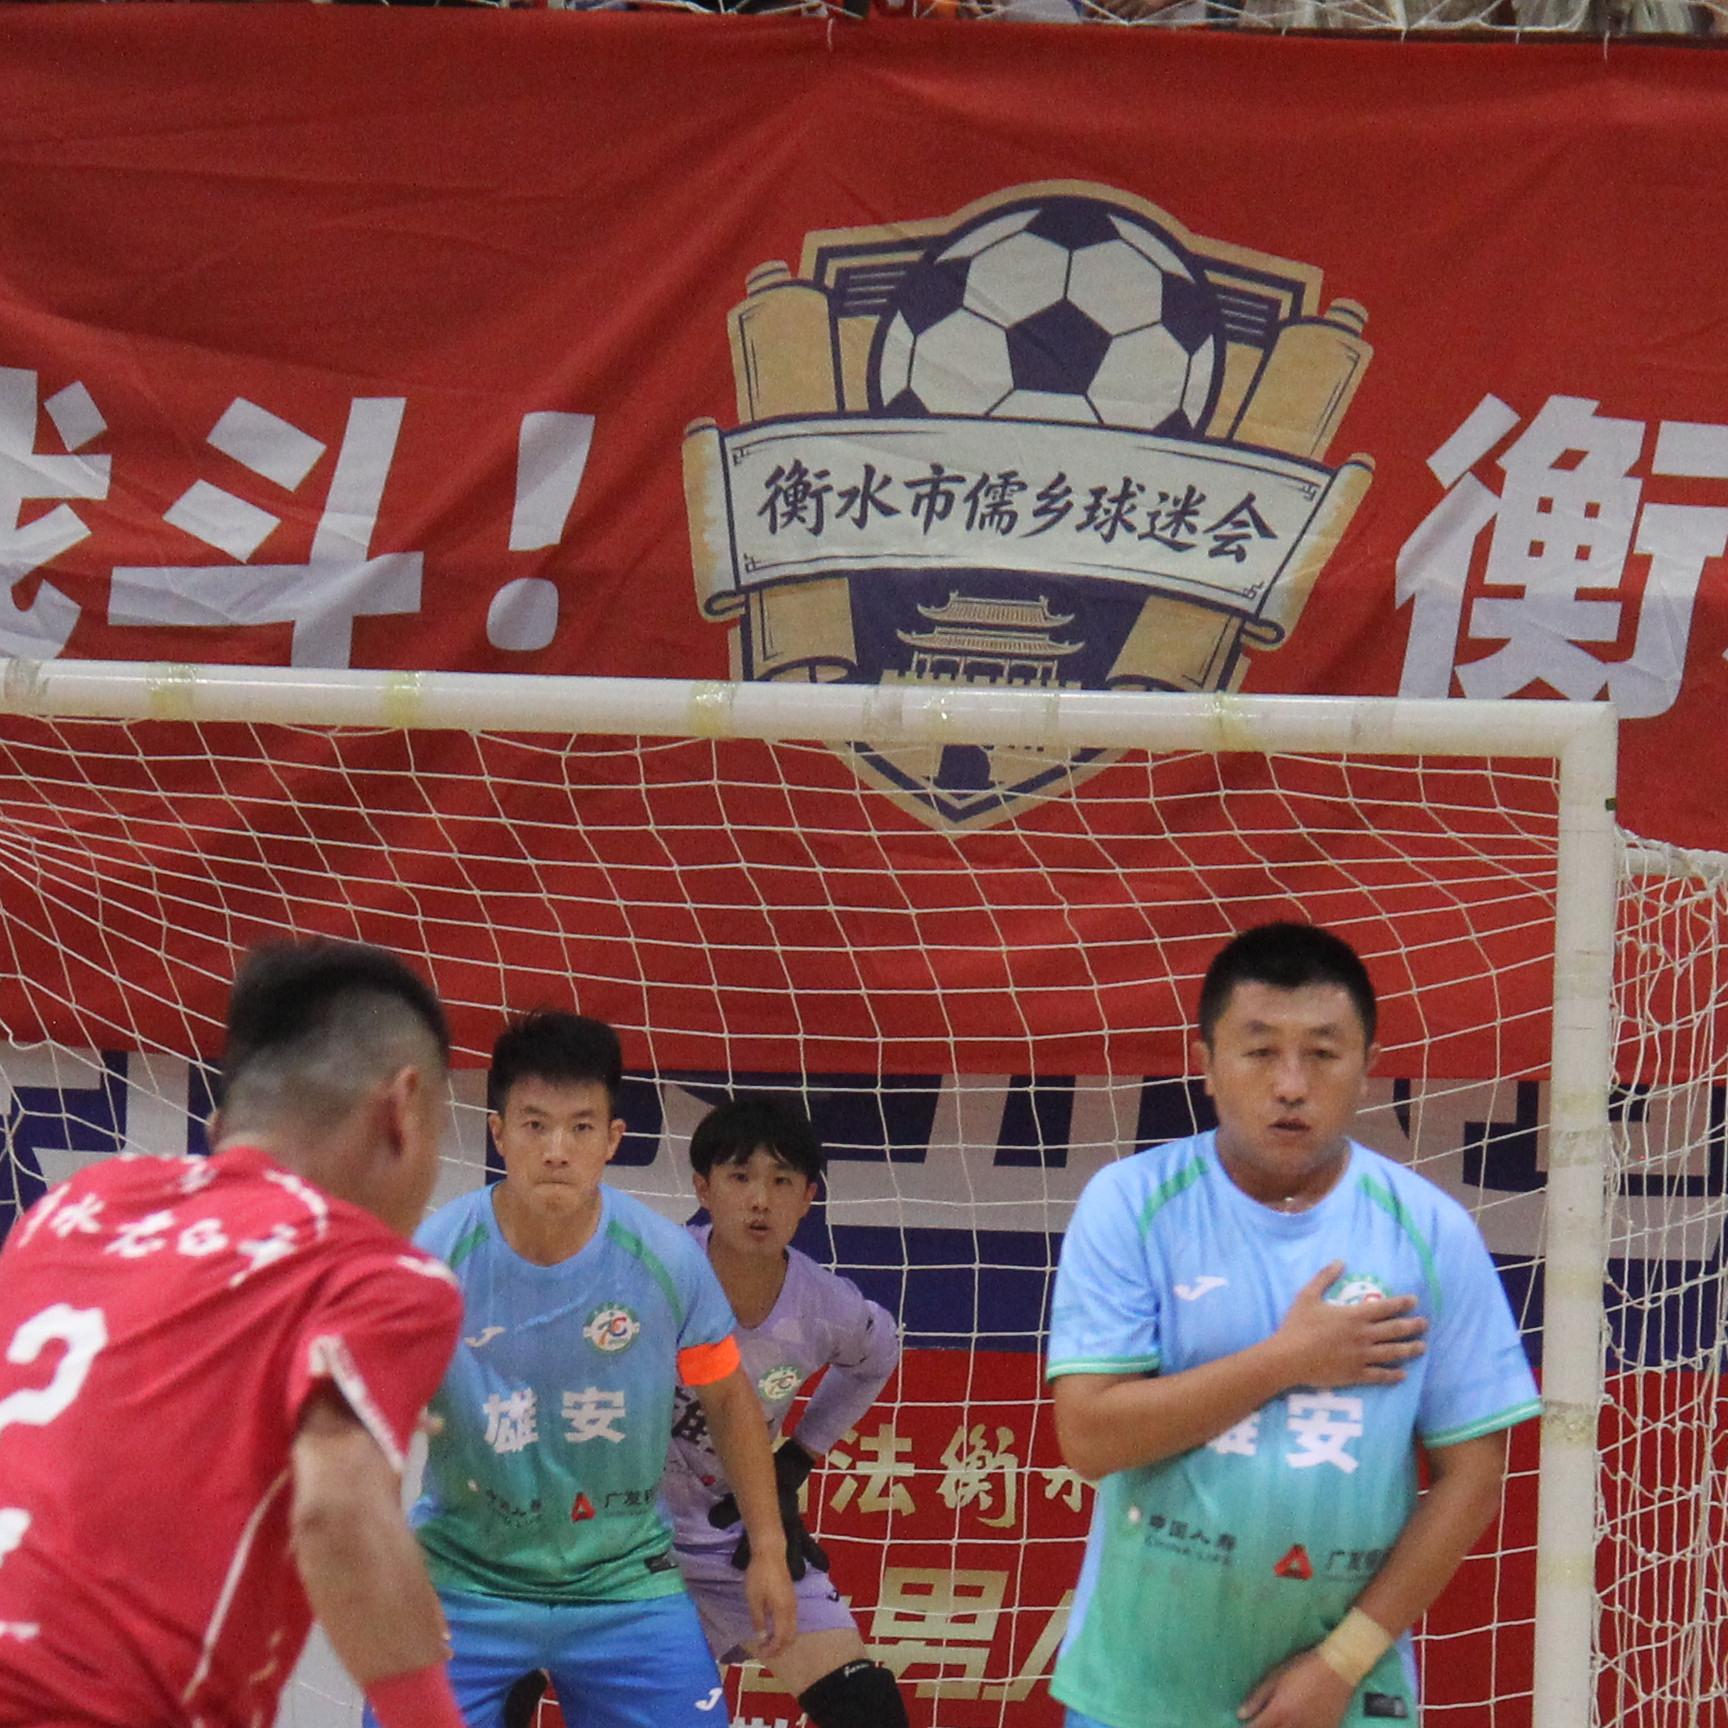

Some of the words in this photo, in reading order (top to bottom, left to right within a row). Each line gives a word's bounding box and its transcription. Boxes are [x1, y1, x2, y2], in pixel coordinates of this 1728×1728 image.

[758, 459, 1278, 563] 衡水市儒乡球迷会
[483, 1387, 626, 1453] 雄安
